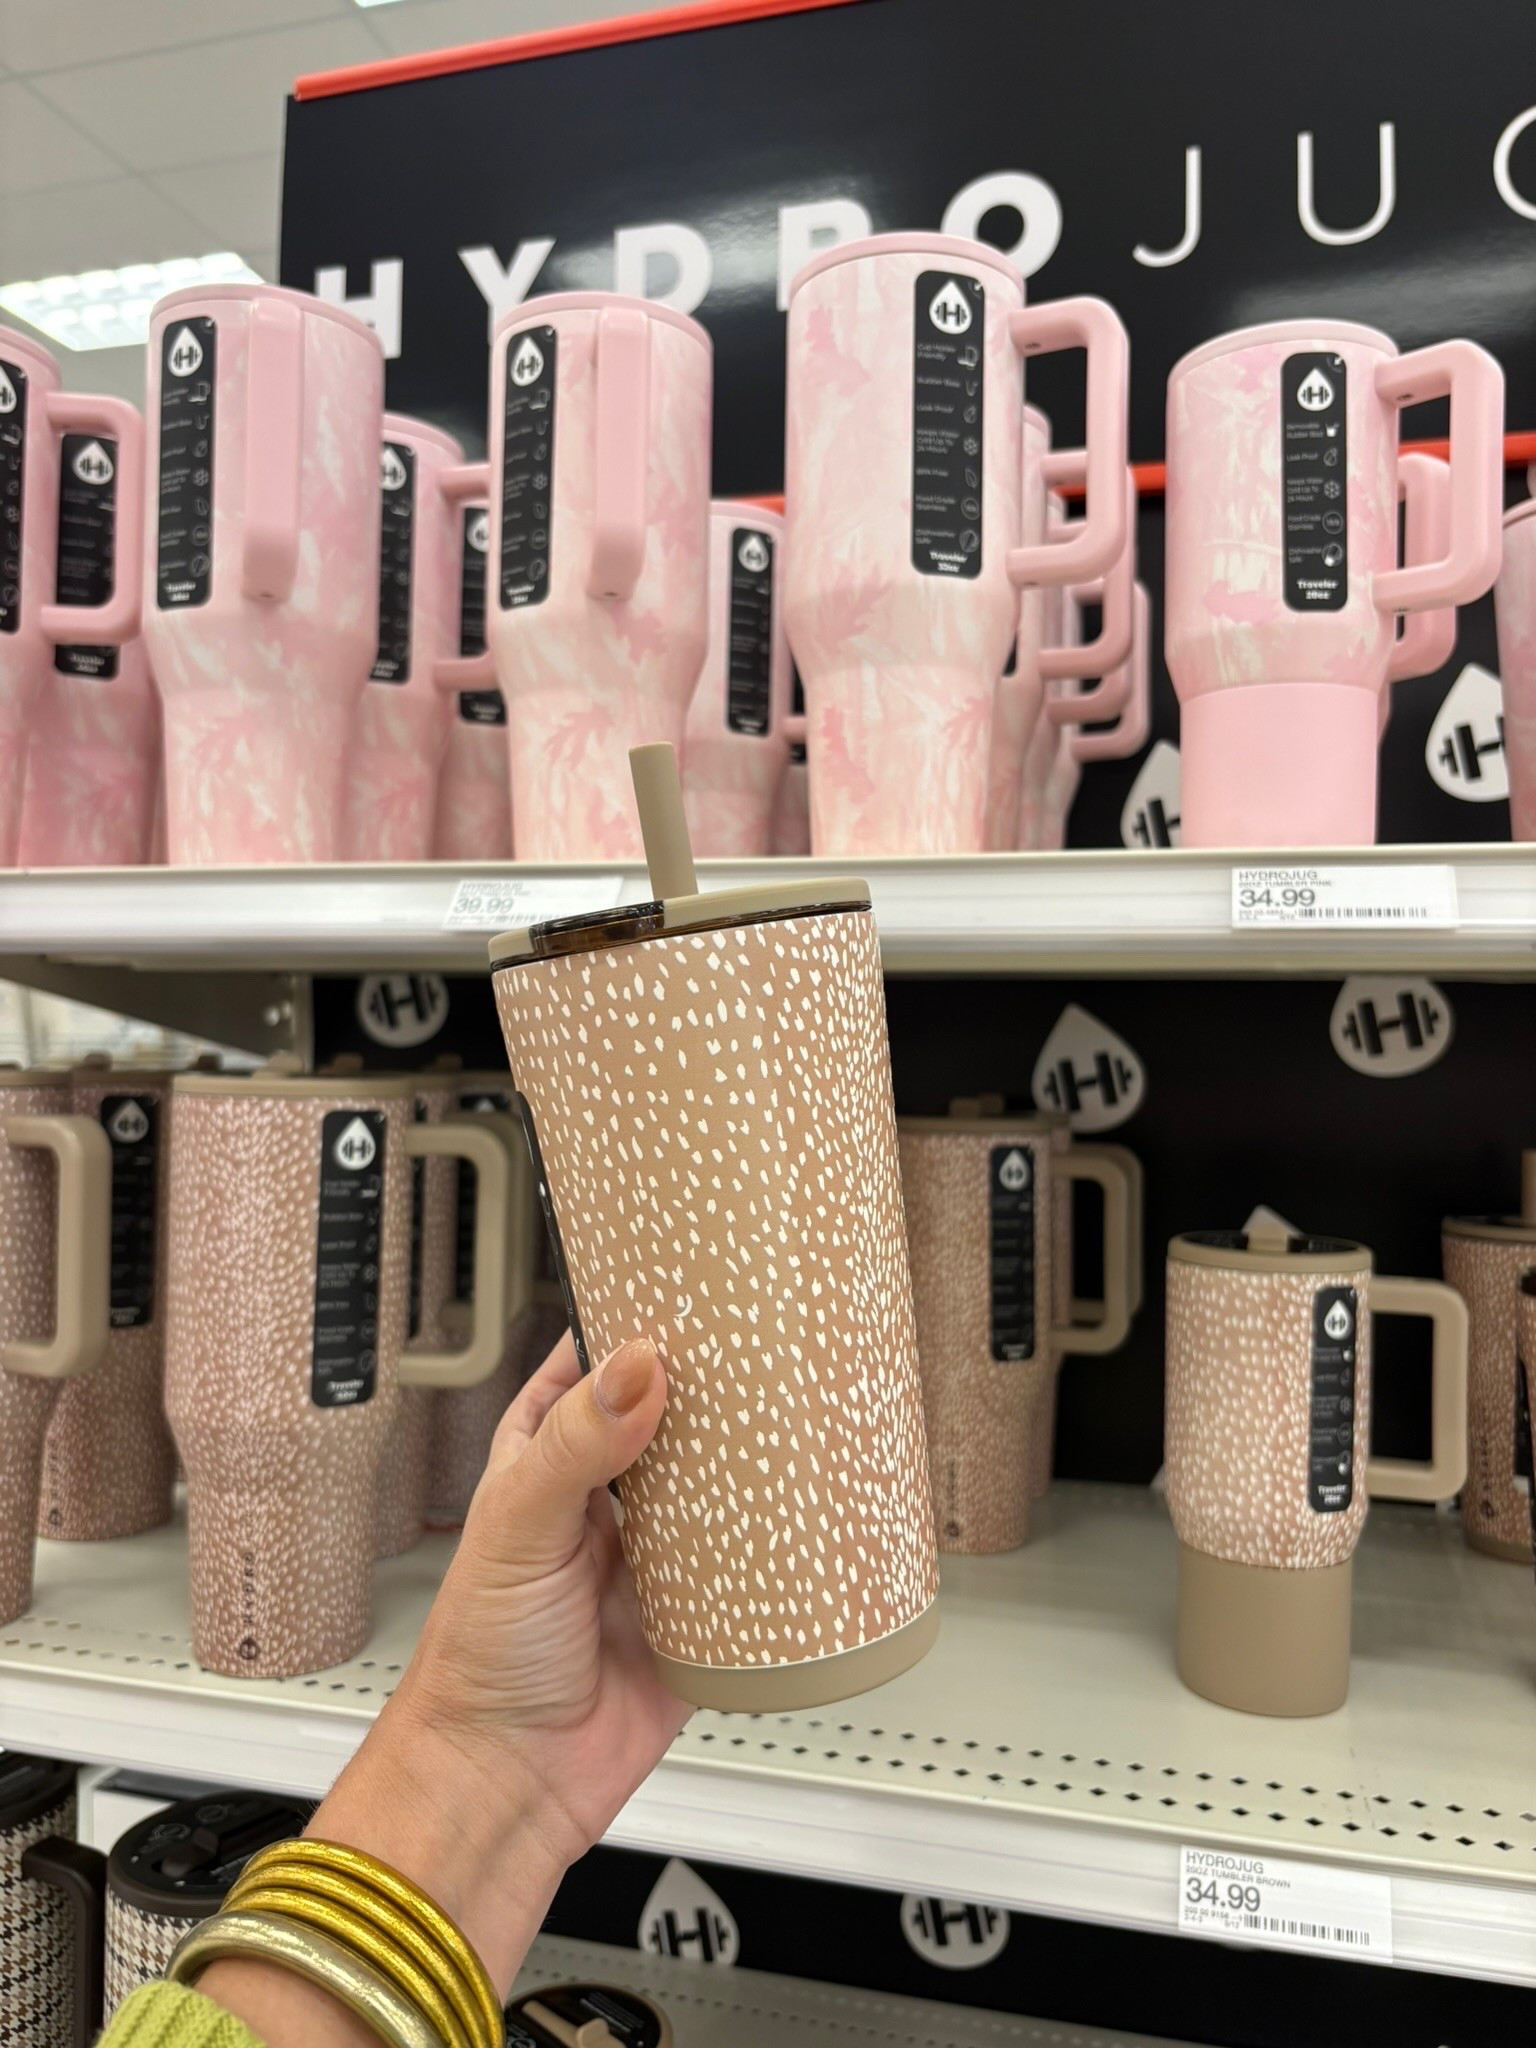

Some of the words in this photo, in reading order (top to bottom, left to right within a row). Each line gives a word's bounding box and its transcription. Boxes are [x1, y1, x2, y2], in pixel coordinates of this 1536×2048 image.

[1239, 888, 1316, 908] 34.99
[1186, 1851, 1264, 1874] HYDROJUG
[1186, 1877, 1261, 1912] 34.99
